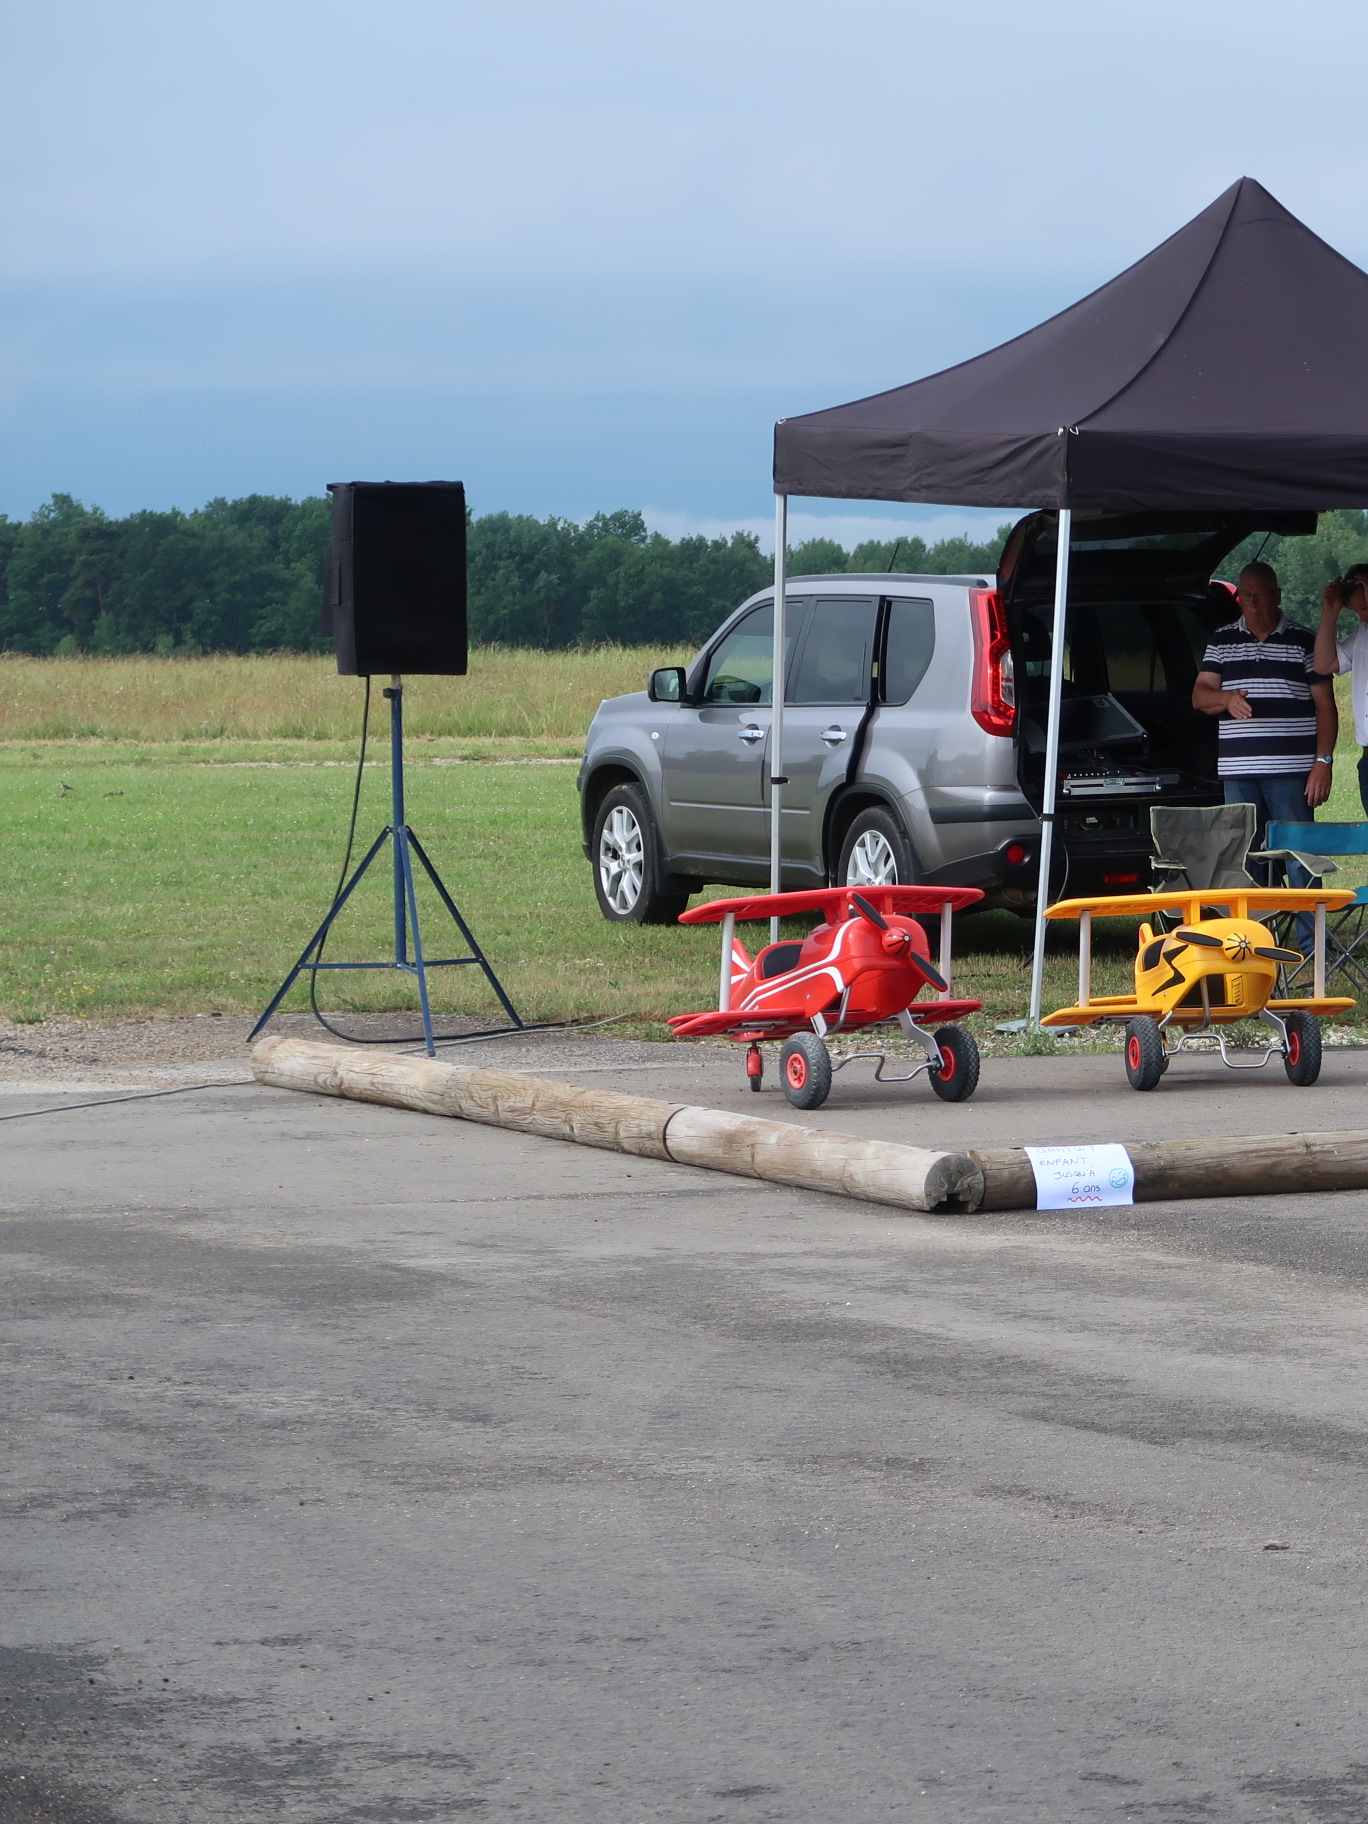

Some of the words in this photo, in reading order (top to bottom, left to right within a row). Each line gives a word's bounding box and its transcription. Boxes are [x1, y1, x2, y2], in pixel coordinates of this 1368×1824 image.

[1039, 1156, 1088, 1166] ENFANT
[1071, 1181, 1080, 1194] 6
[1083, 1184, 1101, 1193] ans
